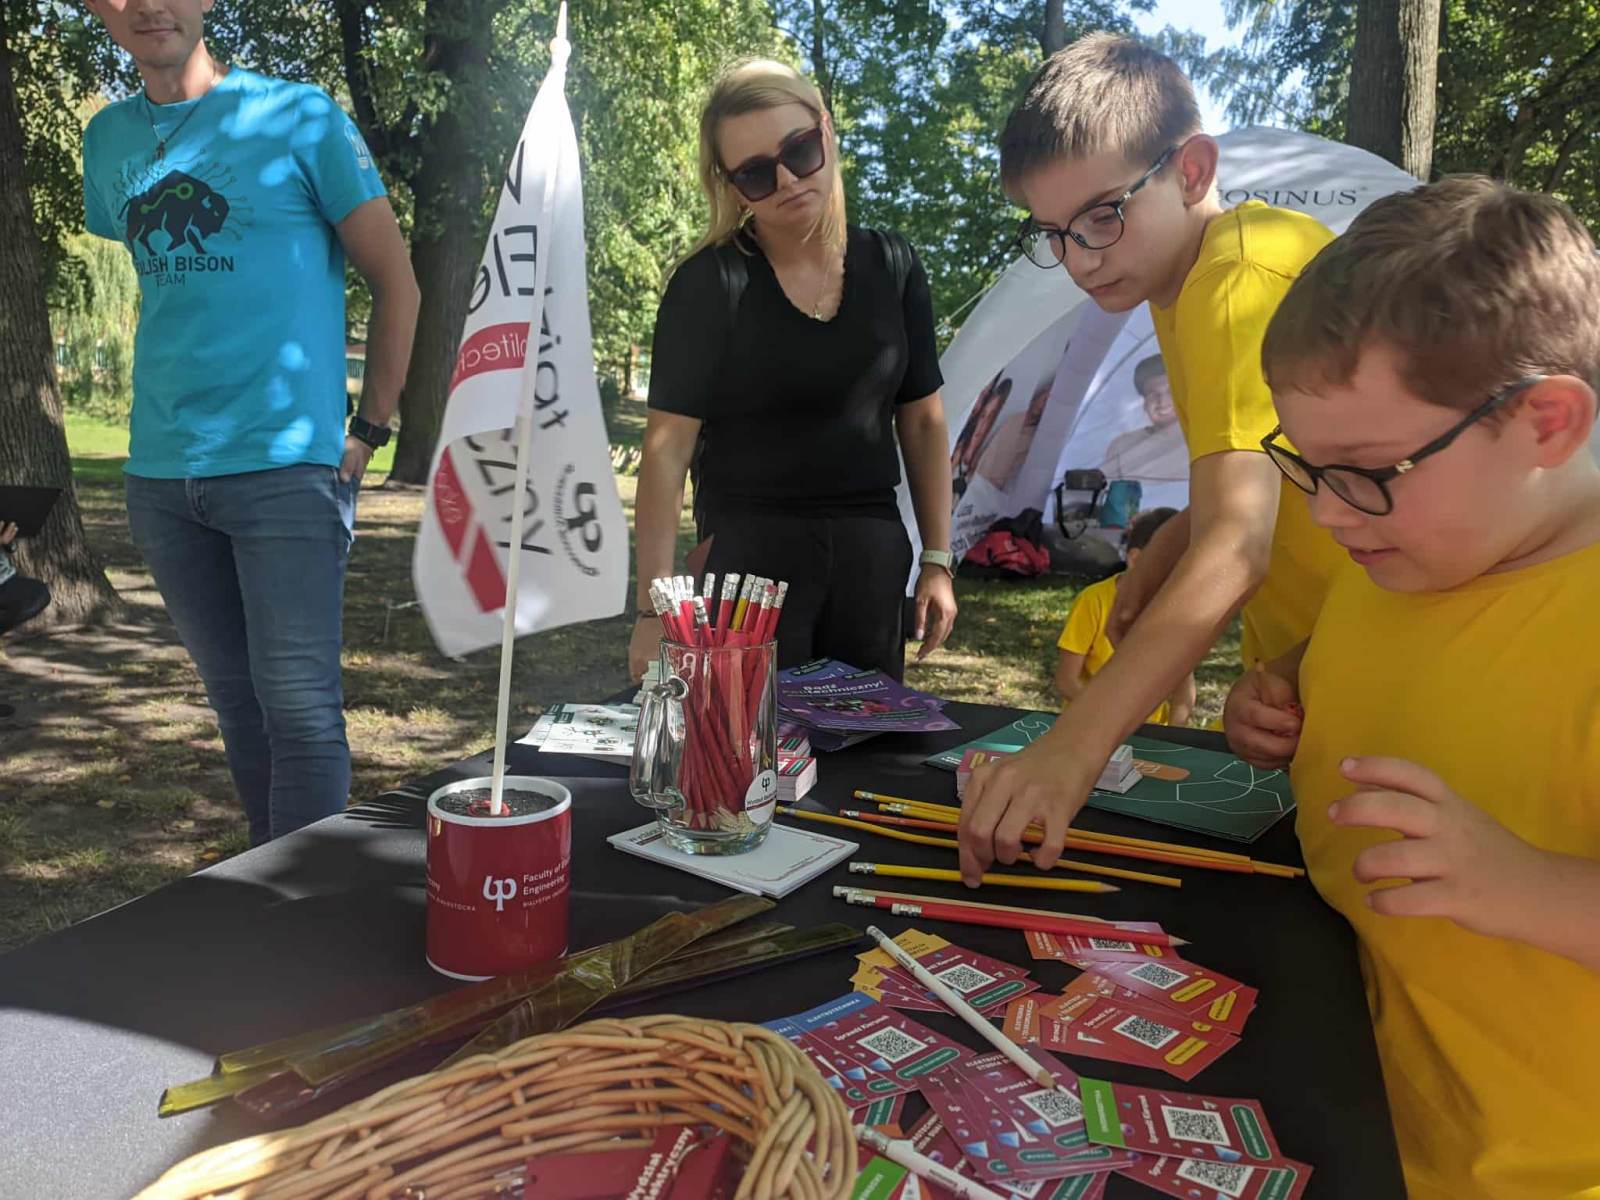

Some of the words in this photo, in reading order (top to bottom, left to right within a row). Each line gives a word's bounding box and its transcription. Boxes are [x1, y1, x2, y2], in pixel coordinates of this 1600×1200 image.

[1218, 188, 1357, 206] OSINUS
[174, 255, 234, 272] BISON
[155, 272, 185, 287] TEAM
[523, 869, 553, 883] Faculty
[523, 874, 565, 896] Engineering
